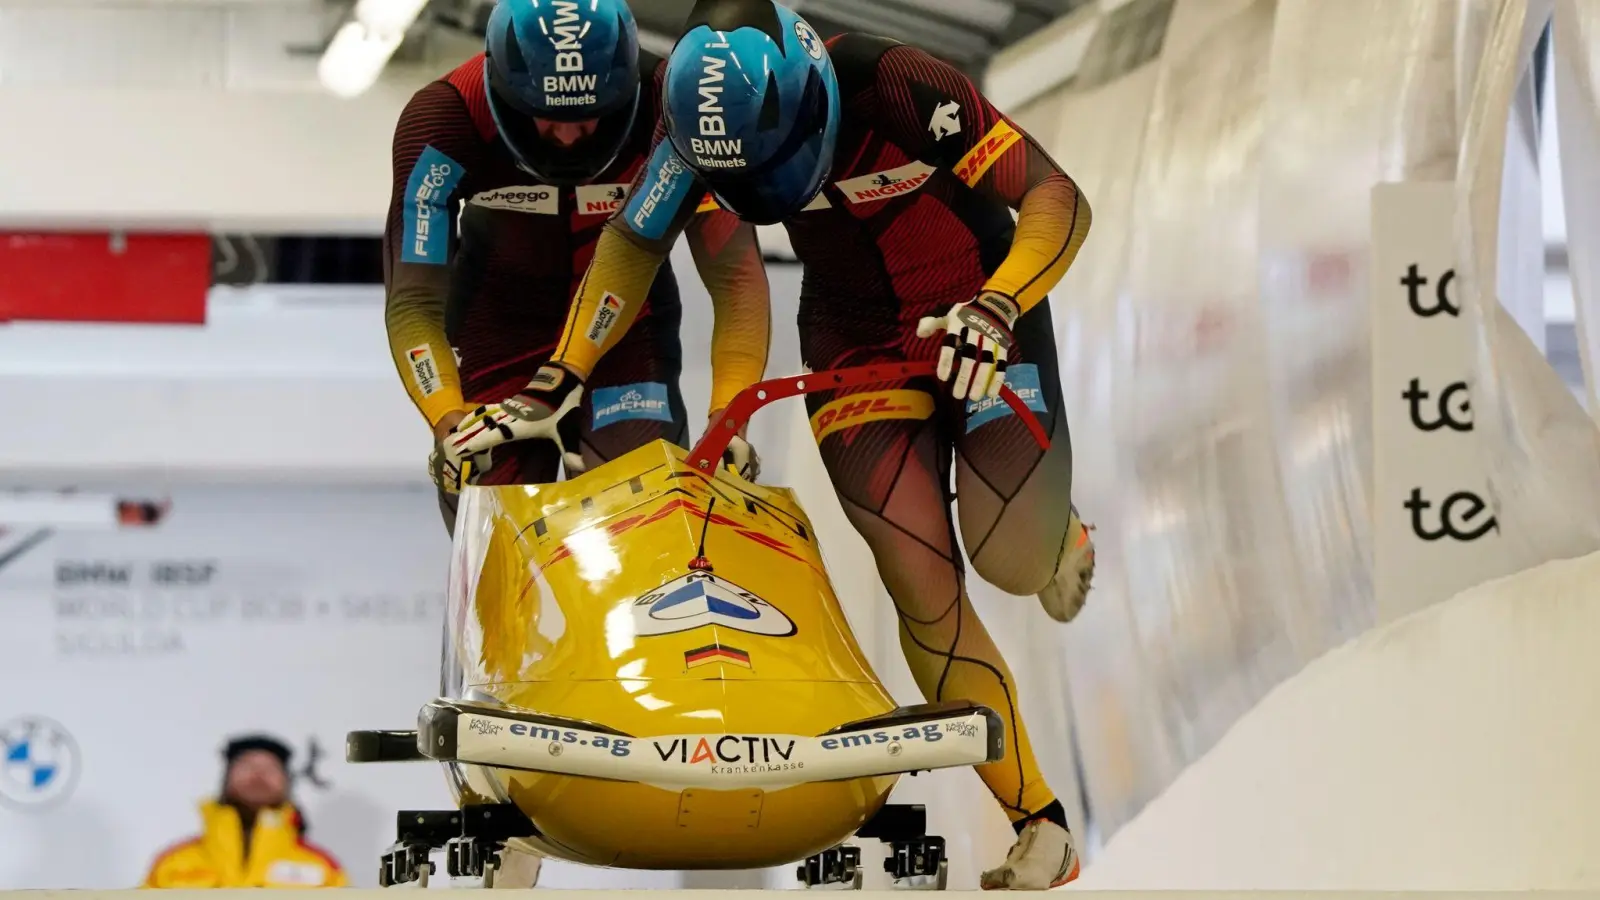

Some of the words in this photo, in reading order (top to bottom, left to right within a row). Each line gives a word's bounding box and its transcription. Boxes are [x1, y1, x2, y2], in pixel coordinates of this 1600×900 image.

[551, 1, 583, 72] BMW
[543, 75, 597, 92] BMW
[698, 55, 726, 136] BMW
[545, 94, 597, 106] helmets
[690, 138, 742, 156] BMW
[696, 155, 747, 168] helmets
[957, 136, 1006, 184] DHL
[480, 191, 550, 204] wheego
[853, 173, 931, 200] NIGRIN
[967, 314, 1003, 344] SEIZ
[816, 396, 901, 430] DHL
[509, 722, 632, 757] ems.ag
[653, 734, 796, 765] VIACTIV
[820, 721, 943, 751] ems.ag
[711, 760, 804, 774] Krankenkasse
